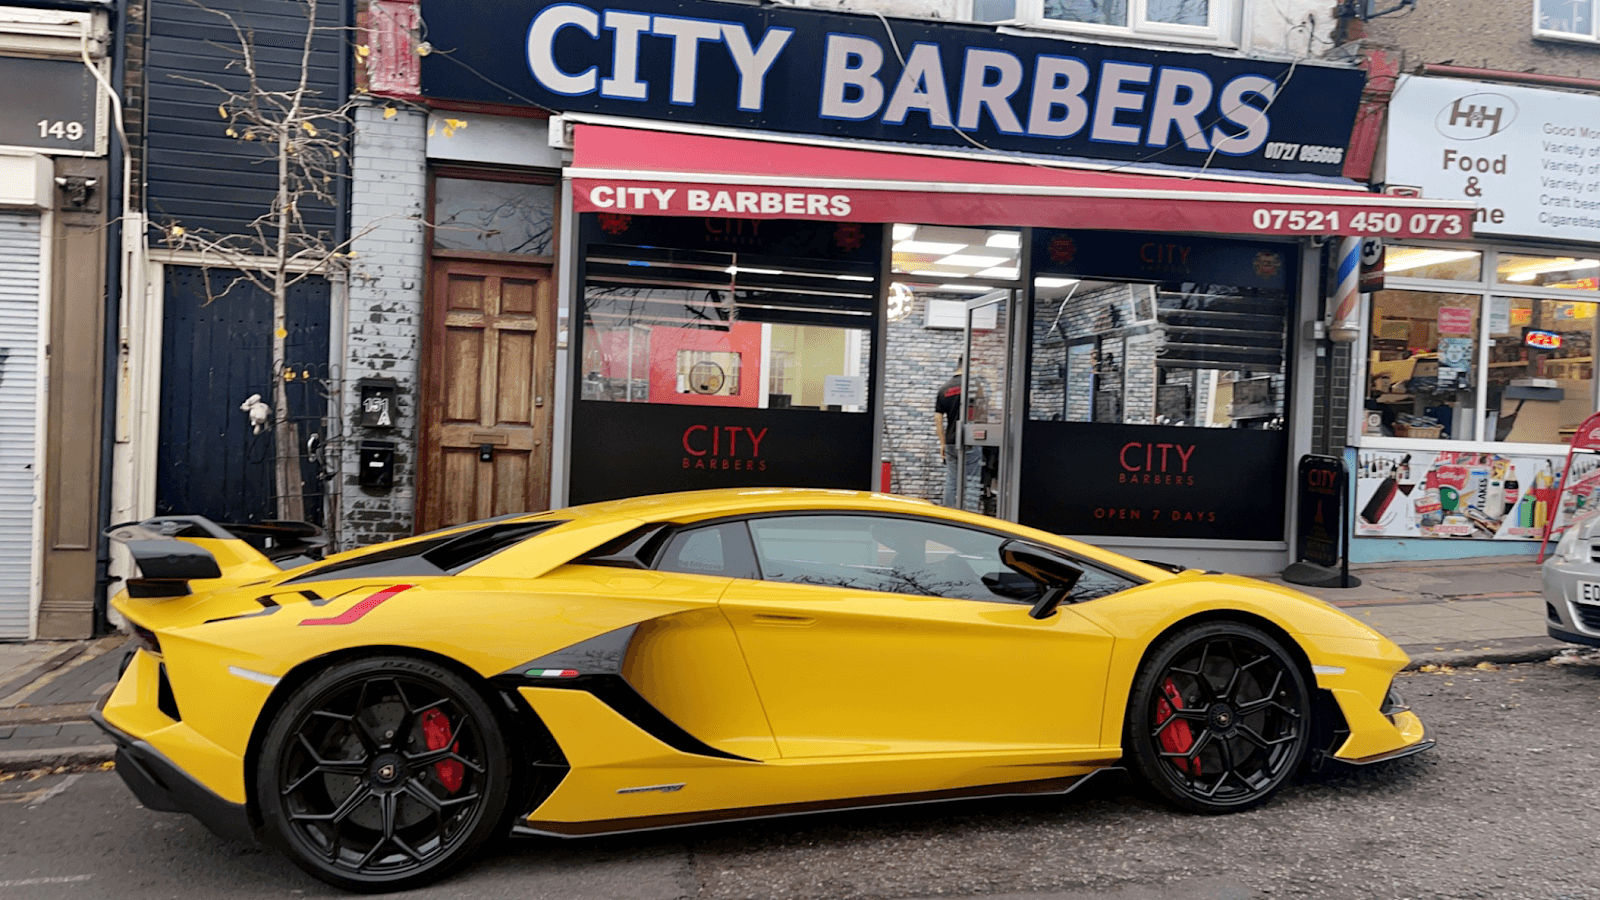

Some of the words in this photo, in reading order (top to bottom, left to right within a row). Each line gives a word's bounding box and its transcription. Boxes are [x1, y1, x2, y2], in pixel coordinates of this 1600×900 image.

[525, 3, 795, 111] CITY
[818, 31, 1278, 158] BARBERS
[37, 119, 84, 141] 149
[1542, 122, 1577, 137] Good
[1542, 140, 1586, 158] Variety
[1443, 148, 1507, 175] Food
[1541, 158, 1584, 176] Variety
[1464, 176, 1482, 198] &
[1540, 175, 1583, 194] Variety
[1586, 181, 1600, 193] of
[589, 186, 676, 210] CITY
[687, 189, 851, 217] BARBERS
[1539, 193, 1571, 208] Craft
[1252, 208, 1340, 231] 07521
[1349, 211, 1402, 233] 450
[1409, 213, 1463, 235] 073
[1140, 242, 1192, 264] CITY
[377, 411, 391, 426] A
[682, 424, 768, 458] CITY
[682, 457, 767, 472] BARBERS
[1119, 441, 1196, 473] CITY
[1118, 473, 1195, 486] BARBERS
[1308, 468, 1337, 488] CITY
[1094, 507, 1140, 519] OPEN
[1152, 509, 1160, 520] 7
[1171, 510, 1216, 522] DAYS
